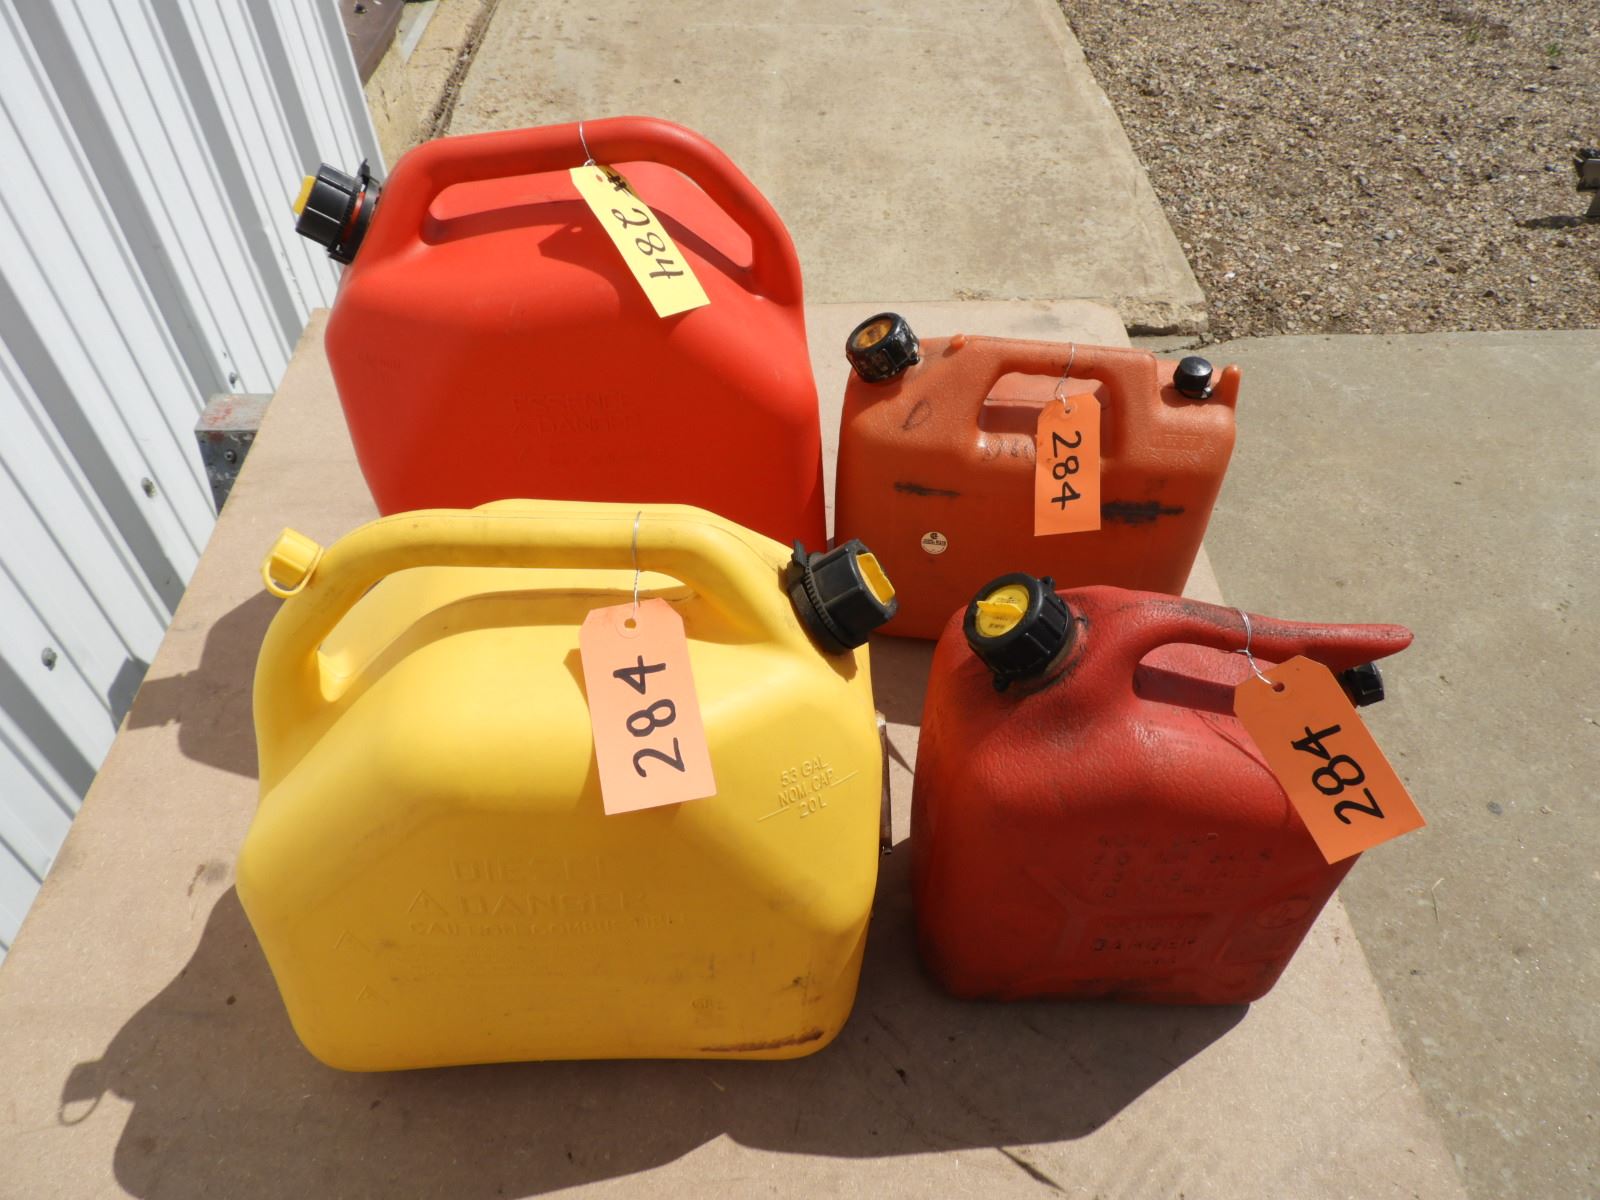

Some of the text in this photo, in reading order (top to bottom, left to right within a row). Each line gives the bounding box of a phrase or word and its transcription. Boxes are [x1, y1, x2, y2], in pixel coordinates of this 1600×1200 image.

[611, 207, 684, 279] 284
[1051, 430, 1082, 510] 284
[613, 655, 685, 777] 284
[800, 755, 831, 778] GAL
[1290, 724, 1385, 825] 284
